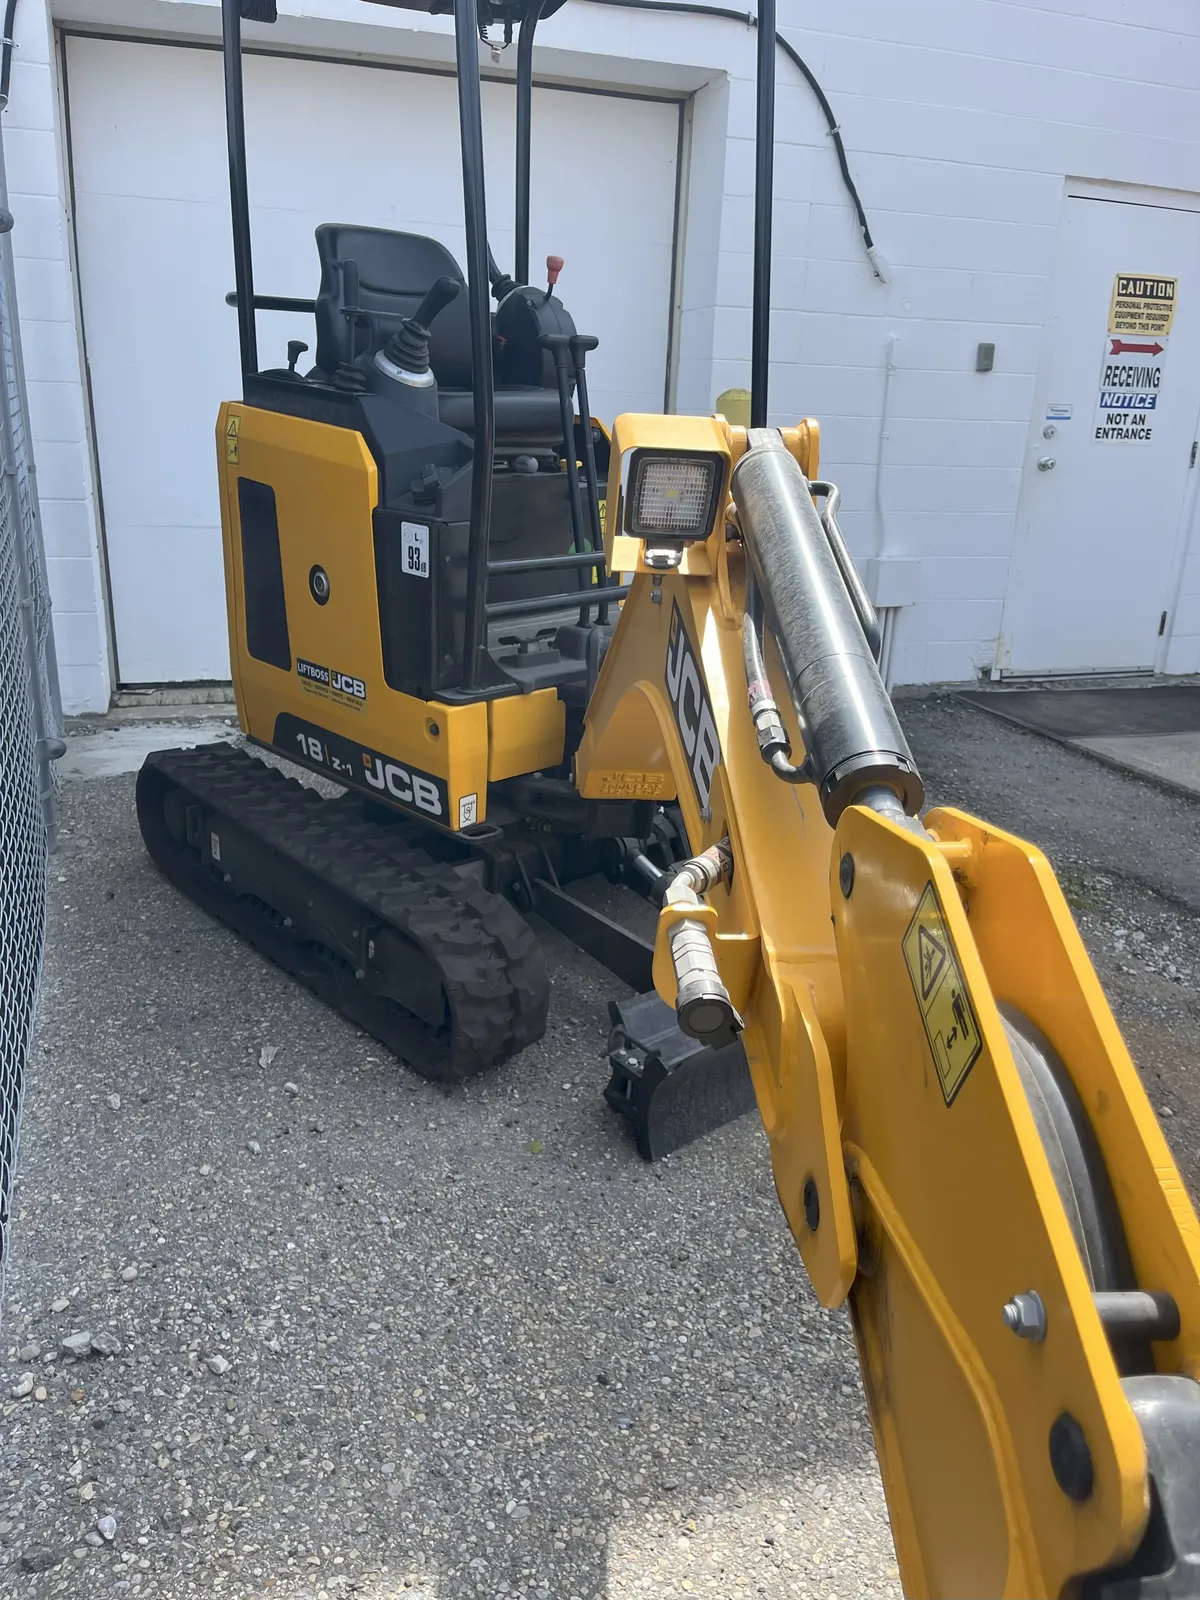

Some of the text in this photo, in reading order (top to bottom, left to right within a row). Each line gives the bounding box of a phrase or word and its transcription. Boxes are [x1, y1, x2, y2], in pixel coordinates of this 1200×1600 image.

[1119, 279, 1173, 298] CAUTION
[1115, 300, 1173, 312] PERSONAL PROTECTIVE
[1114, 310, 1170, 322] EQUIPMENT REQUIRED
[1115, 321, 1165, 331] BEYOND THIS POINT
[1103, 365, 1161, 388] RECEIVING
[1101, 393, 1155, 407] NOTICE
[1106, 413, 1146, 426] NOT AN
[1095, 427, 1152, 440] ENTRANCE
[297, 662, 329, 682] LIFTBOSS
[332, 674, 365, 698] JCB
[346, 695, 363, 707] RENTALS
[666, 628, 721, 809] JCB
[296, 733, 323, 762] 18
[364, 757, 443, 816] JCB
